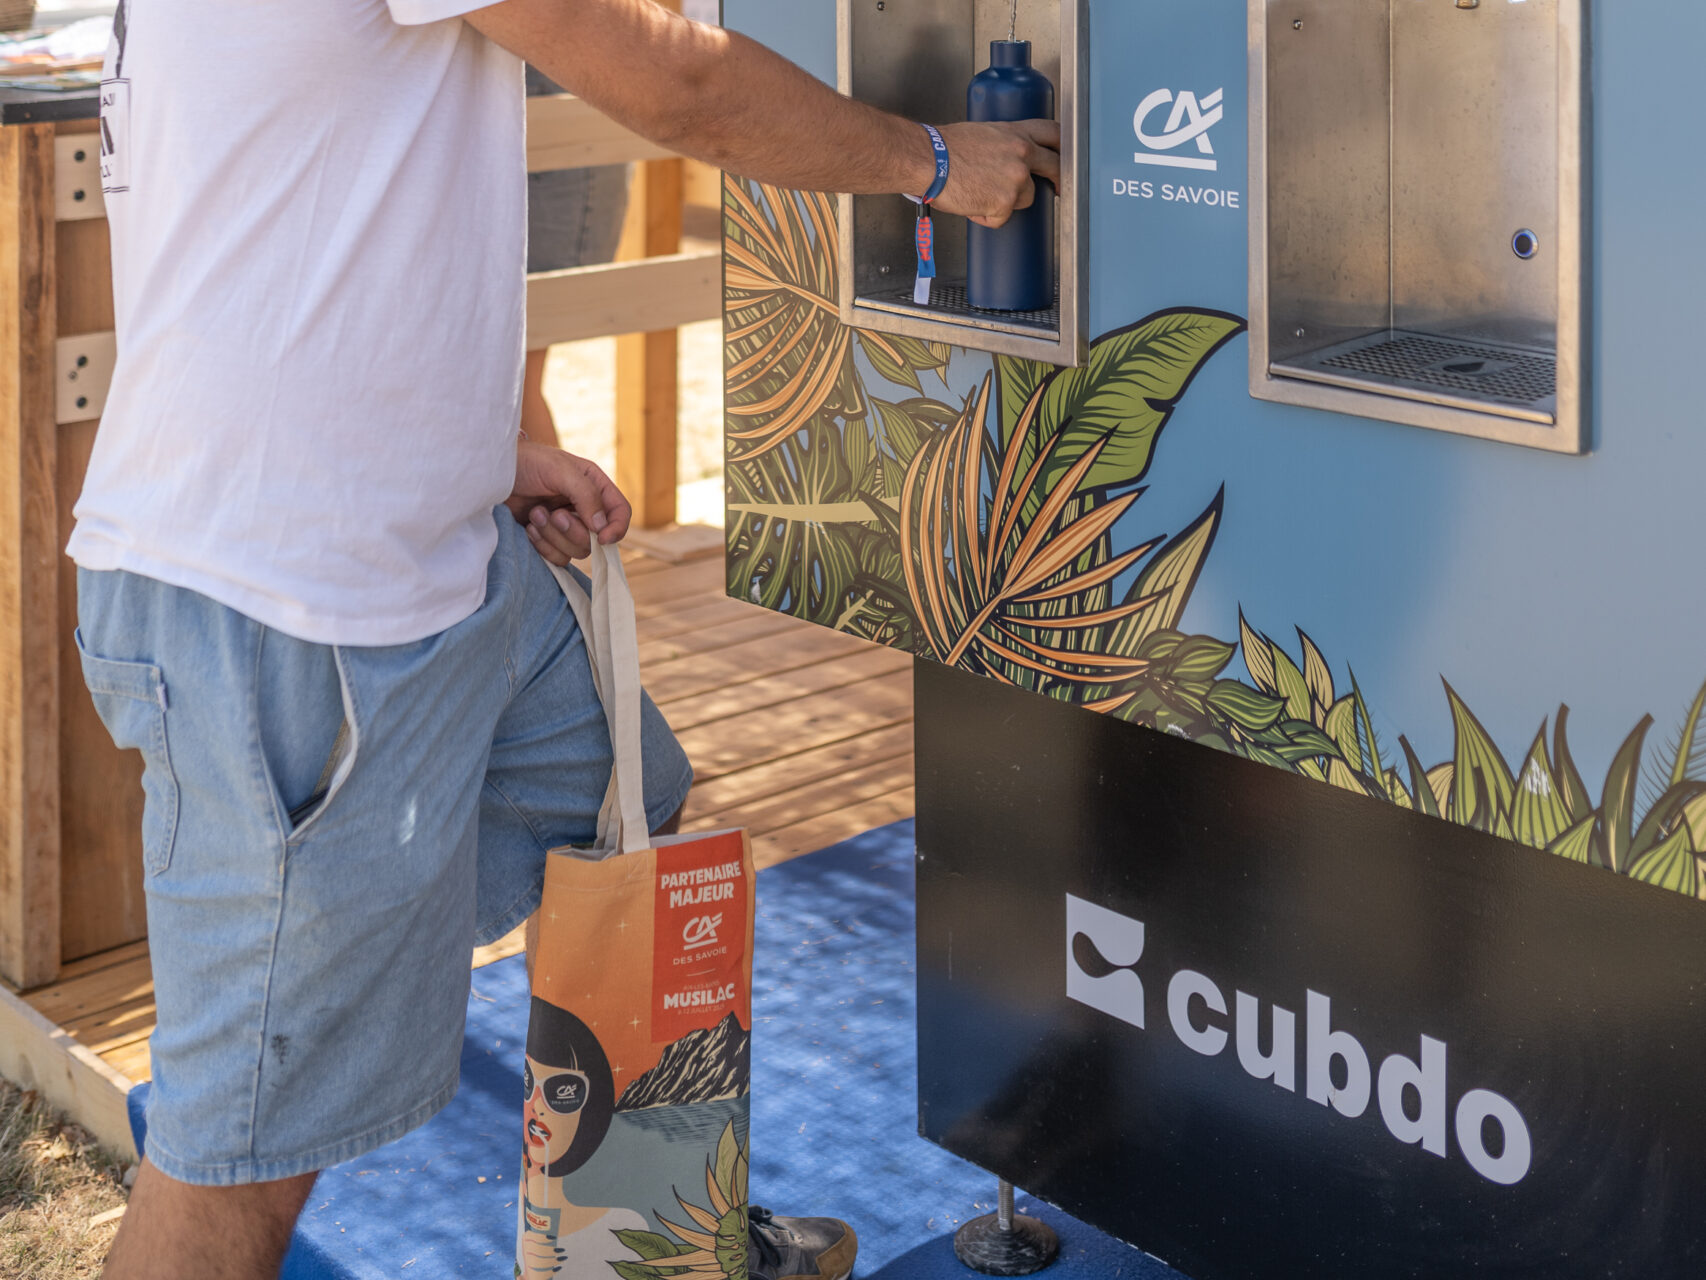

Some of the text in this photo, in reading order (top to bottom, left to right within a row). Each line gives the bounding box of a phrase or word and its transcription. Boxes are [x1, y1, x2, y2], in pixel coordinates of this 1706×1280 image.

[1112, 178, 1240, 209] DES SAVOIE
[661, 860, 742, 890] PARTENAIRE
[669, 882, 734, 909] MAJEUR
[672, 945, 727, 966] DES SAVOIE
[663, 982, 735, 1010] MUSILAC
[1166, 968, 1533, 1186] cubdo
